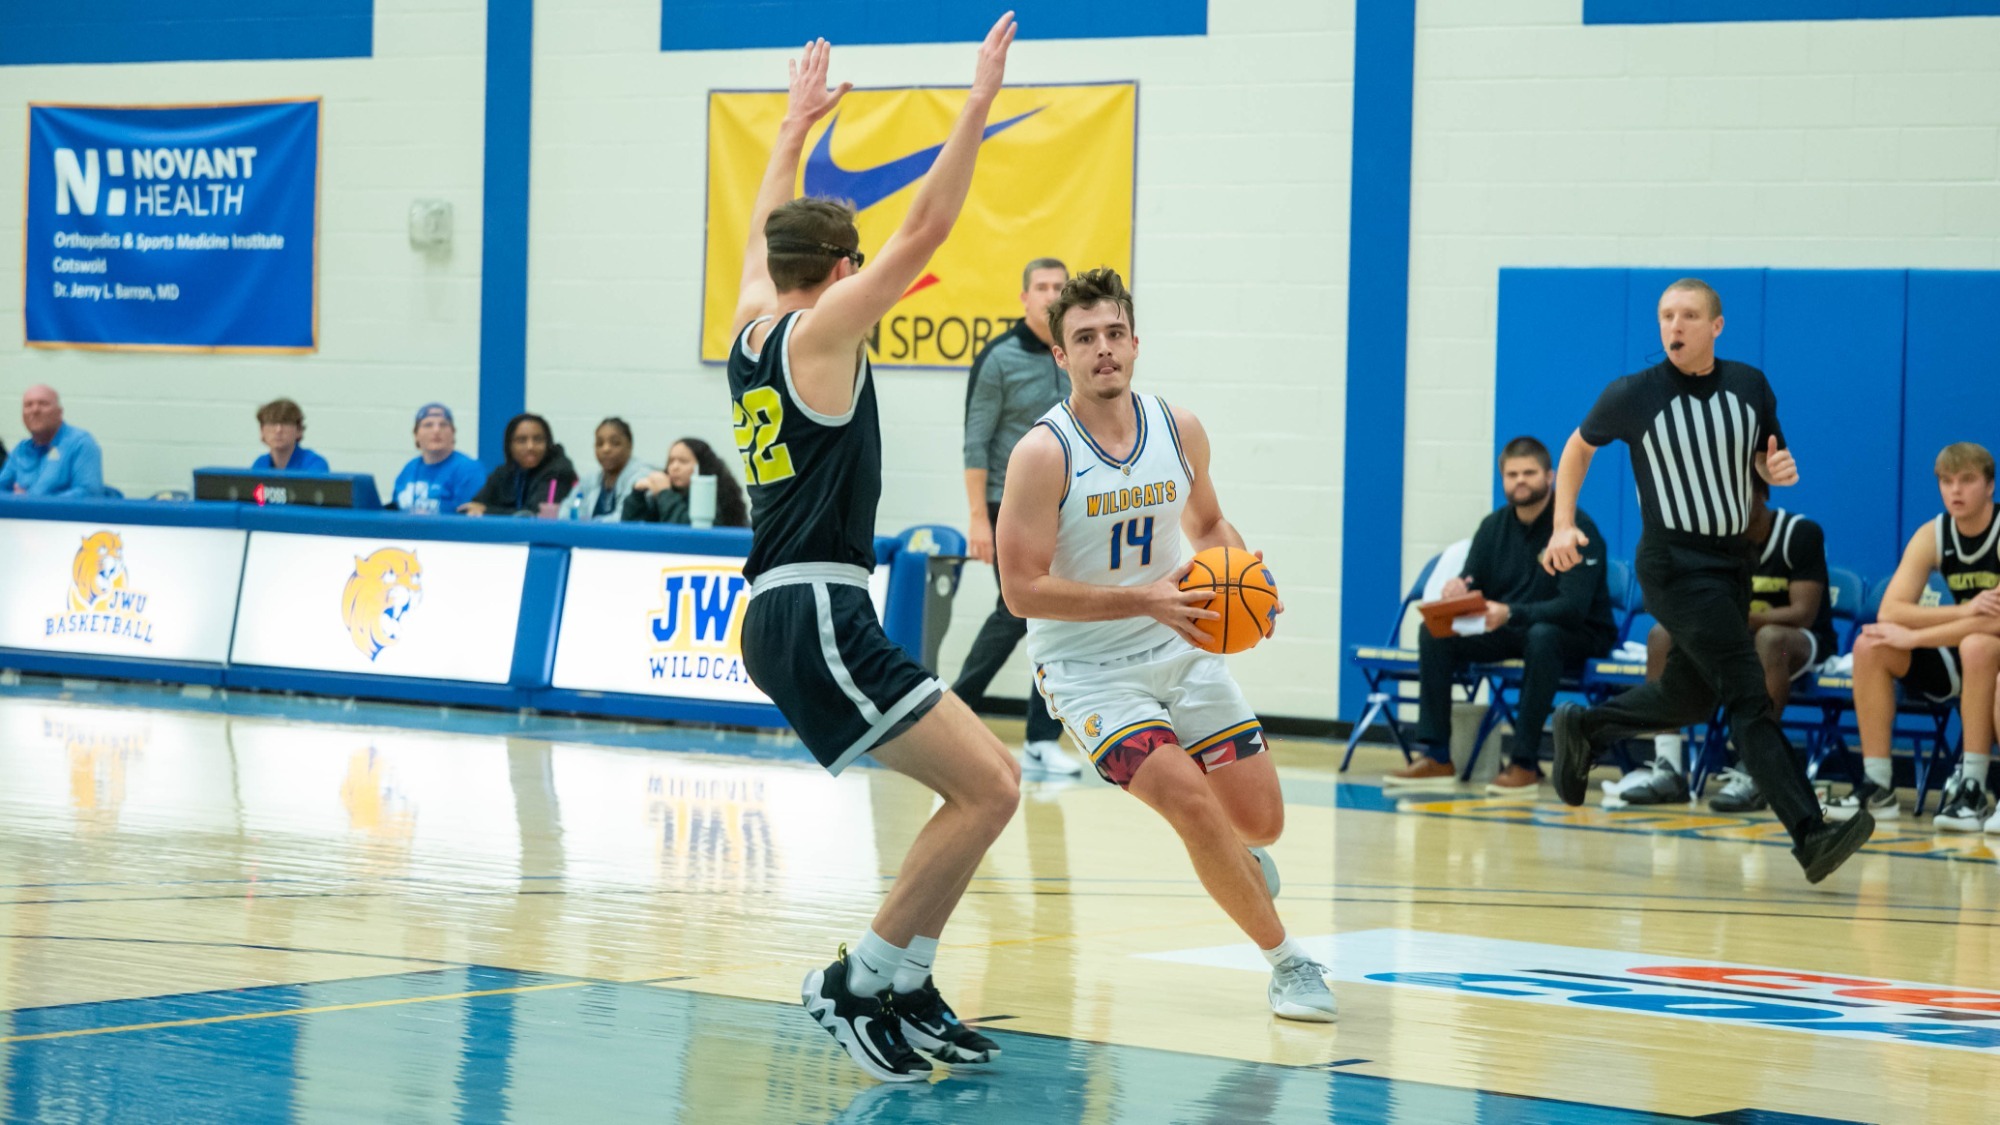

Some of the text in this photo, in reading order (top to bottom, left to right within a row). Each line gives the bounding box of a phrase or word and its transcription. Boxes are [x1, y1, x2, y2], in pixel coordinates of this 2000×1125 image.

[132, 147, 257, 179] NOVANT
[135, 184, 244, 216] HEALTH
[54, 231, 284, 252] Orthopedics & Sports Medicine Institute
[52, 256, 107, 274] Cotswold
[53, 281, 68, 298] Dr.
[70, 282, 102, 301] Jerry
[103, 284, 113, 299] L.
[157, 284, 179, 300] MD
[1086, 480, 1176, 517] WILDCATS
[1109, 516, 1155, 571] 14
[109, 591, 147, 614] JWU
[46, 614, 152, 643] BASKETBALL
[649, 656, 748, 683] WILDCA
